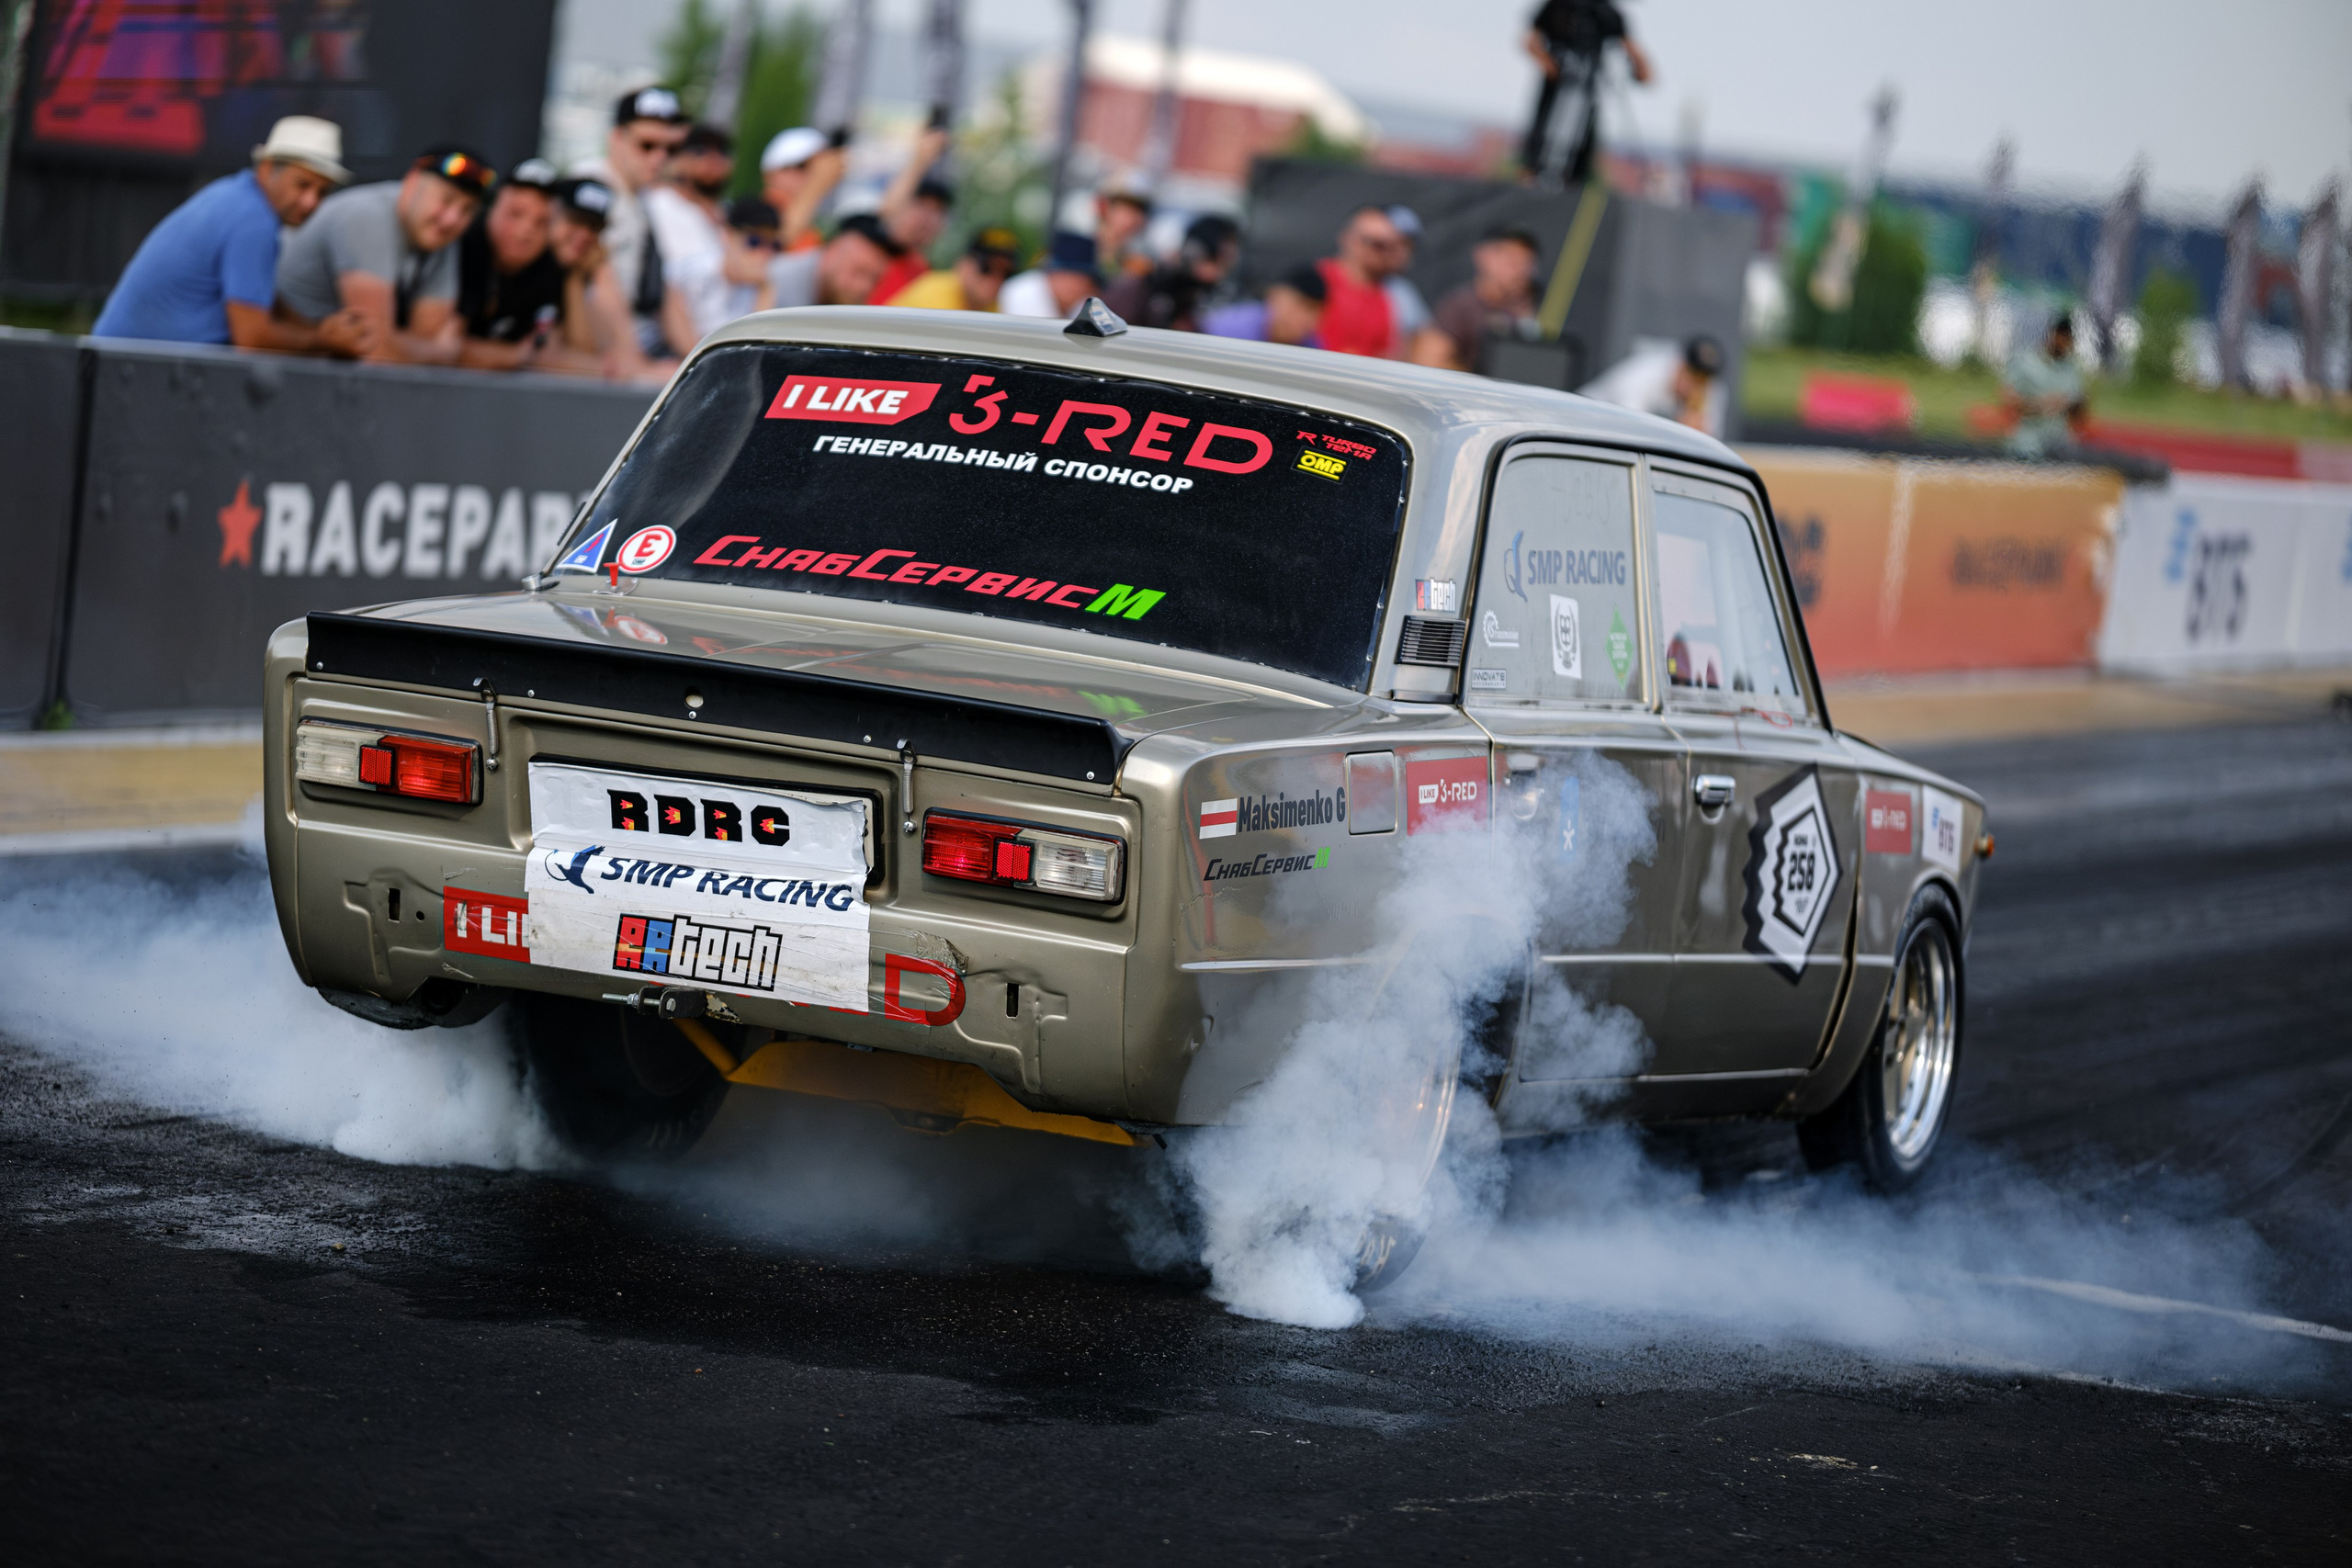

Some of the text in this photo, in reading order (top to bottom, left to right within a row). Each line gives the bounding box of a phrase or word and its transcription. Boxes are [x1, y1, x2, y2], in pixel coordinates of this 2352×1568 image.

[783, 374, 1273, 474] I LIKE 3-RED
[812, 435, 1193, 494] ГЕНЕРАЛЬНЫЙ СПОНСОР
[1300, 454, 1344, 474] OMP
[1321, 434, 1377, 455] TURBO
[260, 479, 590, 581] RACEPAR
[634, 534, 662, 558] E
[1528, 549, 1625, 586] SMP RACING
[1473, 672, 1505, 682] INNOVATE
[1238, 786, 1346, 833] Maksimenko G
[1424, 788, 1435, 799] LIKE
[1440, 778, 1477, 803] 3-RED
[606, 789, 790, 847] RDRC
[600, 857, 854, 912] SMP RACING
[1788, 852, 1815, 892] 258
